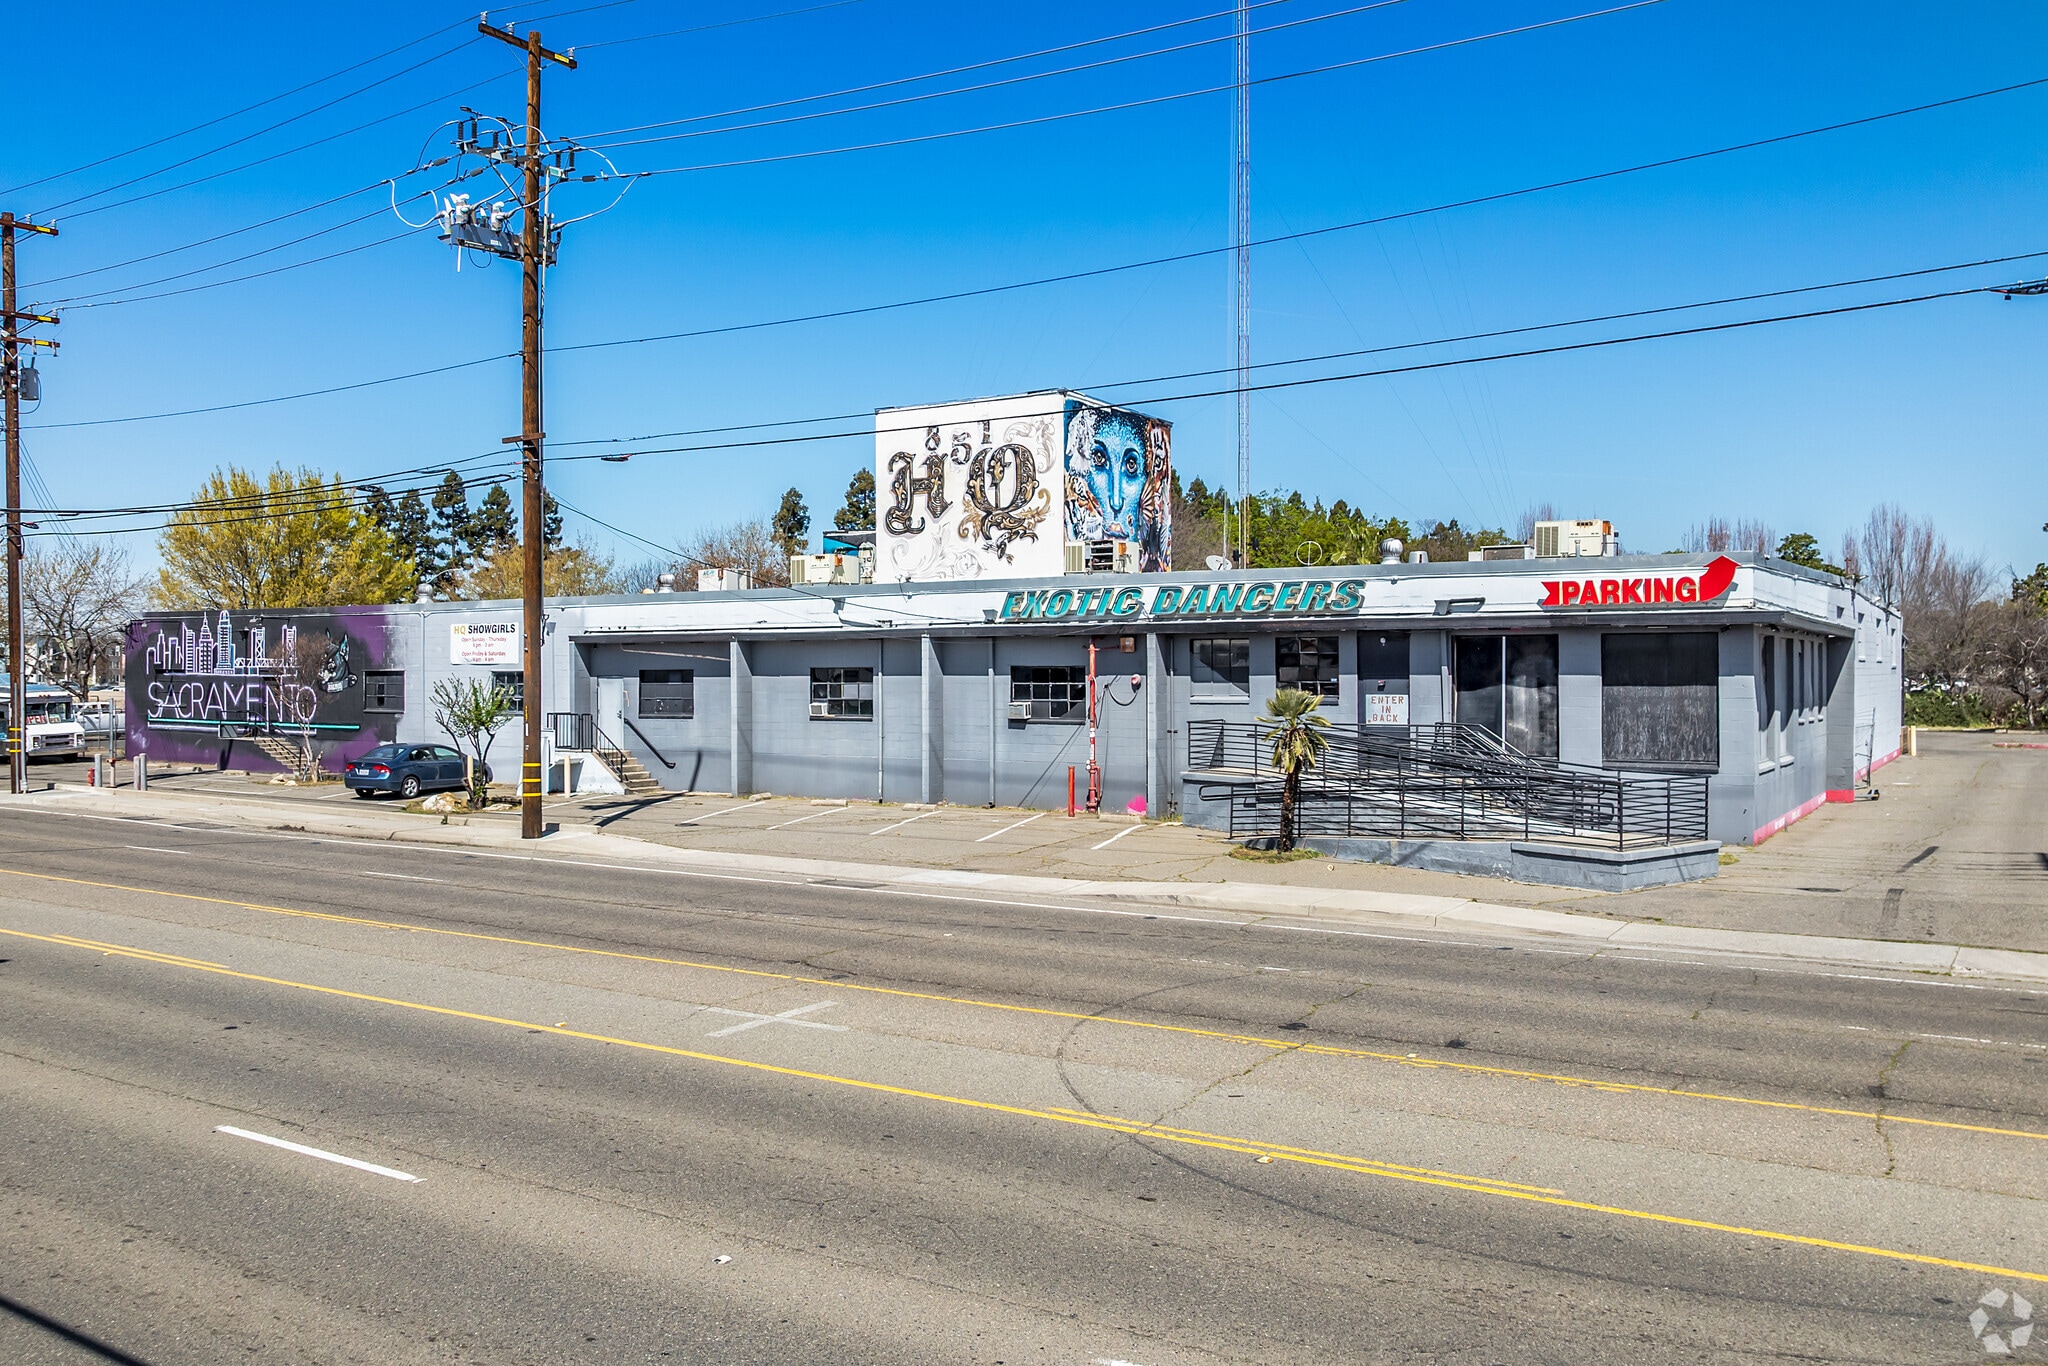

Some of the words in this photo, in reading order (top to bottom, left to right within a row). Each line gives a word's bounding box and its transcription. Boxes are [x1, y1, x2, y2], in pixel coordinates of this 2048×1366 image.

[885, 443, 1043, 545] HQ
[1000, 586, 1144, 619] EXOTIC
[1149, 580, 1367, 616] DANCERS
[1562, 576, 1697, 605] PARKING
[454, 625, 466, 635] HQ
[468, 624, 516, 634] SHOWGIRLS
[147, 681, 318, 732] SACRAMENTO
[1371, 696, 1404, 704] ENTER
[1381, 705, 1391, 714] IN
[1372, 713, 1398, 722] BACK
